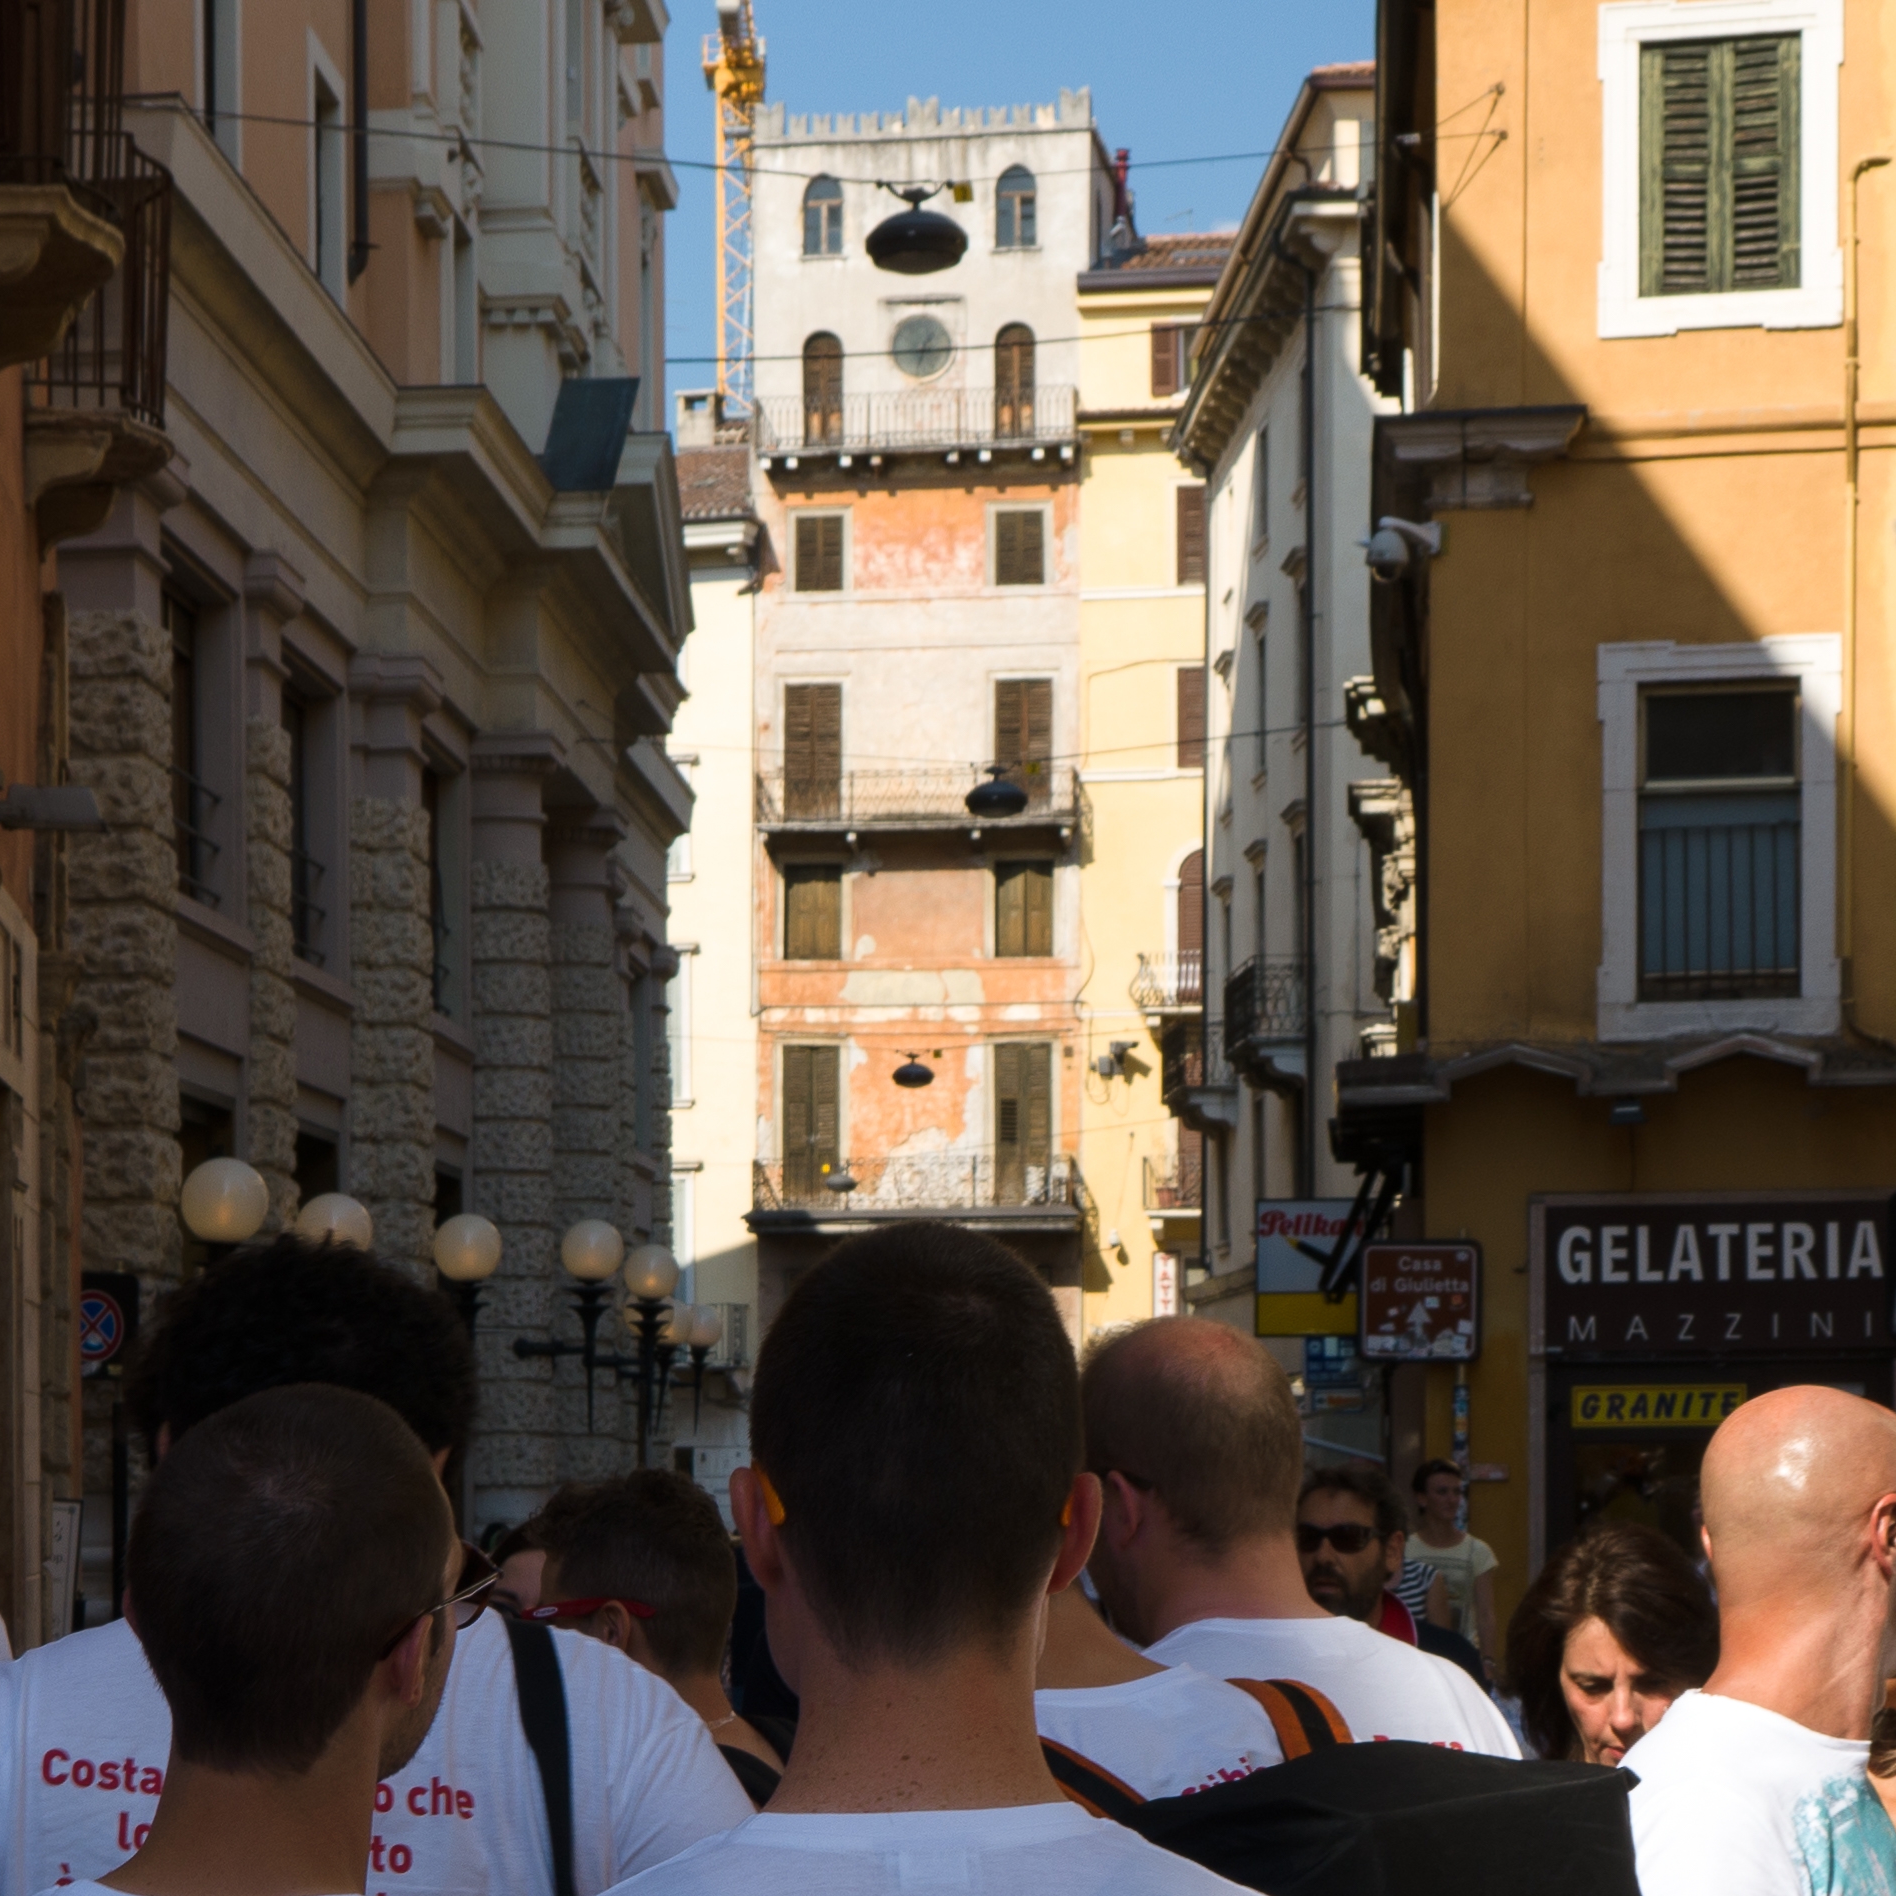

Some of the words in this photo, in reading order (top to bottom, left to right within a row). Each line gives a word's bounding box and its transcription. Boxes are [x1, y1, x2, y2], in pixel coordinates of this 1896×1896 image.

[1397, 1256, 1442, 1272] Casa
[1557, 1220, 1884, 1284] GELATERIA
[1370, 1278, 1386, 1293] di
[1394, 1277, 1470, 1293] Giulietta
[1567, 1312, 1873, 1342] MAZZINI
[1579, 1391, 1741, 1421] GRANITE
[41, 1747, 166, 1796] Costa
[407, 1776, 475, 1820] che
